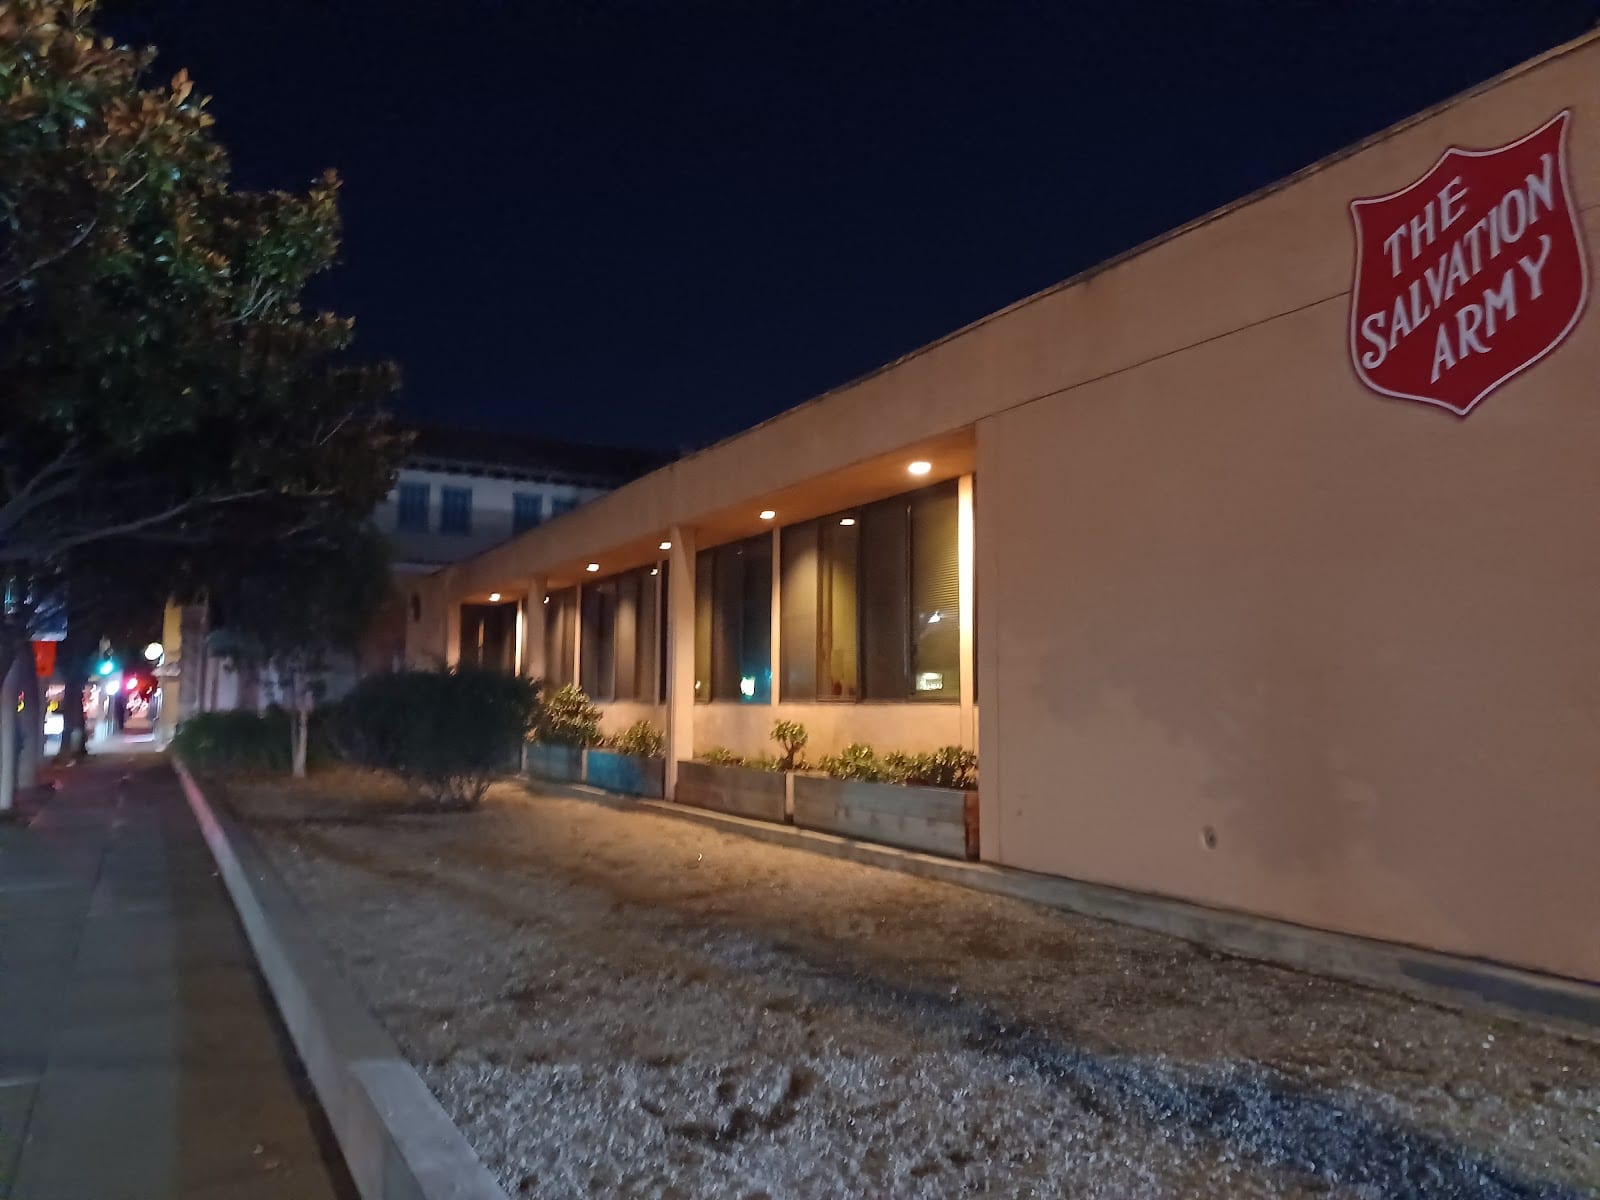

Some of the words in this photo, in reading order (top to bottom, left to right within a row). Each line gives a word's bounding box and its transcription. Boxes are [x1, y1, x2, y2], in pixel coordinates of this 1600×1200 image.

[1361, 154, 1553, 369] SALVATION
[1384, 176, 1468, 278] THE
[1431, 235, 1551, 384] ARMY
